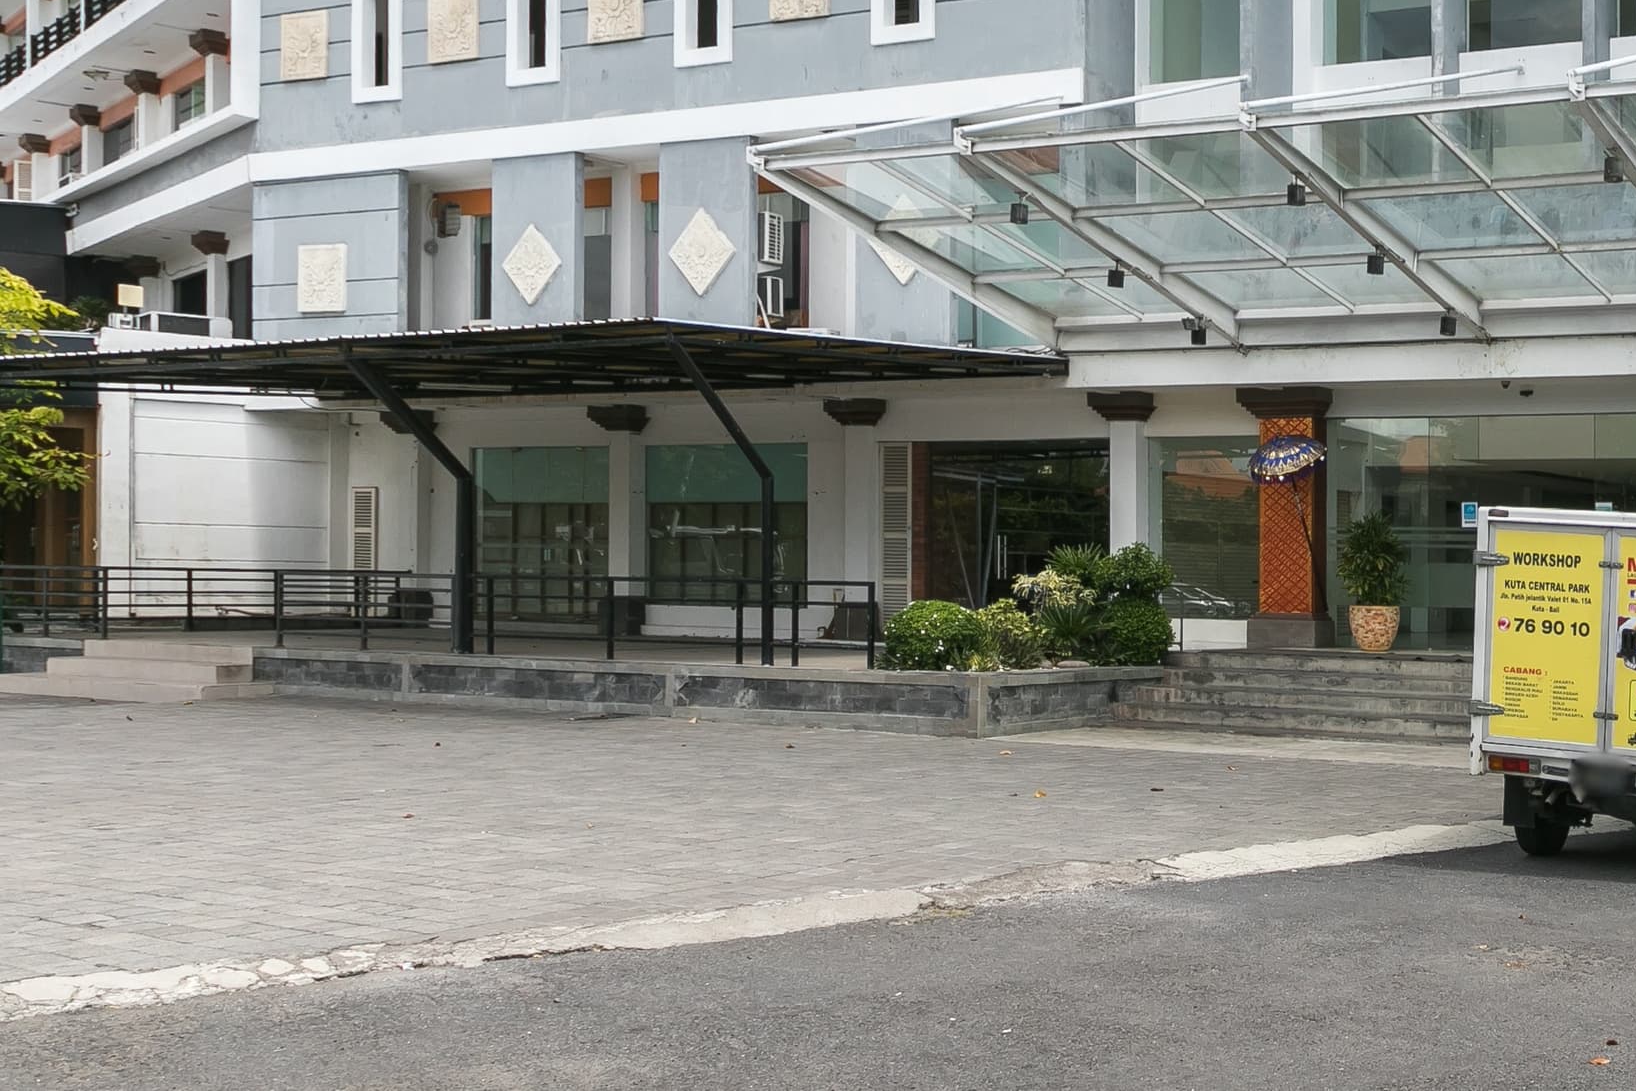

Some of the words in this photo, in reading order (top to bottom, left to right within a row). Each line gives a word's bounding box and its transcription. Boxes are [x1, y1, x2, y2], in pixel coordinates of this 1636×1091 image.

[1513, 552, 1581, 568] WORKSHOP
[1504, 580, 1526, 590] KUTA
[1528, 581, 1566, 592] CENTRAL
[1568, 583, 1590, 594] PARK
[1532, 605, 1545, 613] Kuta
[1514, 618, 1536, 633] 76
[1541, 620, 1565, 636] 90
[1570, 622, 1590, 637] 10
[1503, 666, 1542, 676] CABANG
